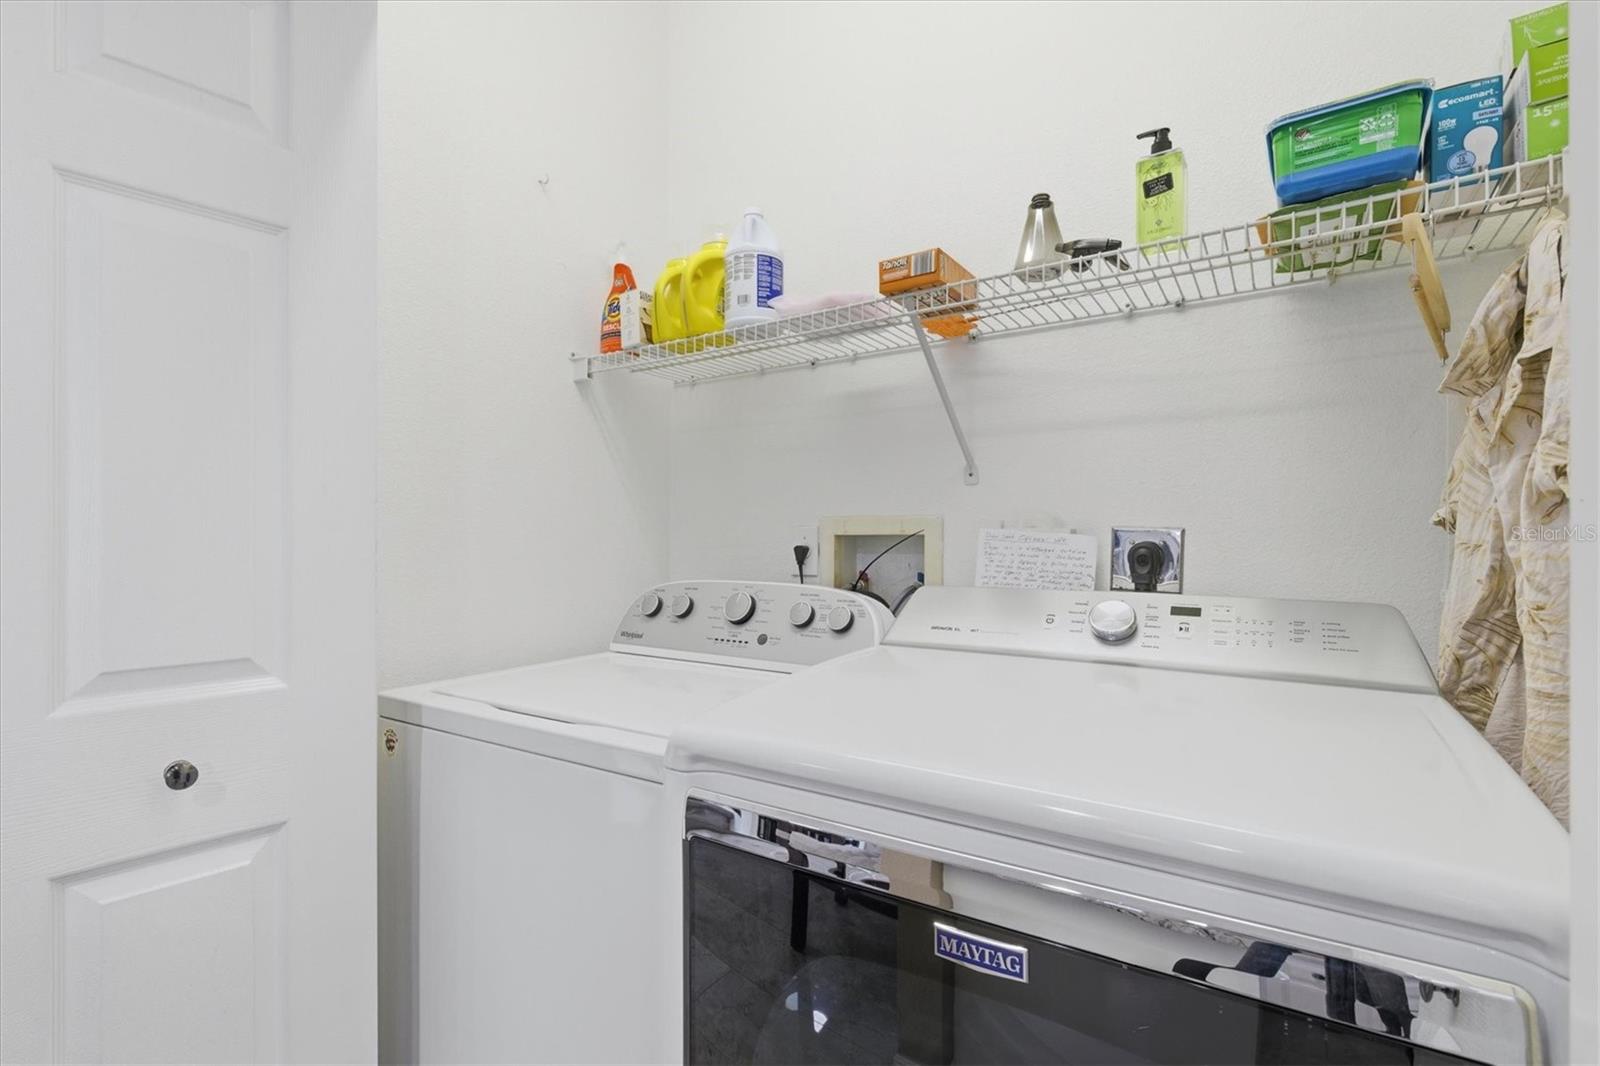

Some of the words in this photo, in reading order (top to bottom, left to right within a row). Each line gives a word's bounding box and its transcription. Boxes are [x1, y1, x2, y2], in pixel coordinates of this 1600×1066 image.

[1448, 88, 1494, 105] ecosmart
[1479, 98, 1496, 107] LED
[939, 934, 1020, 973] MAYTAG
